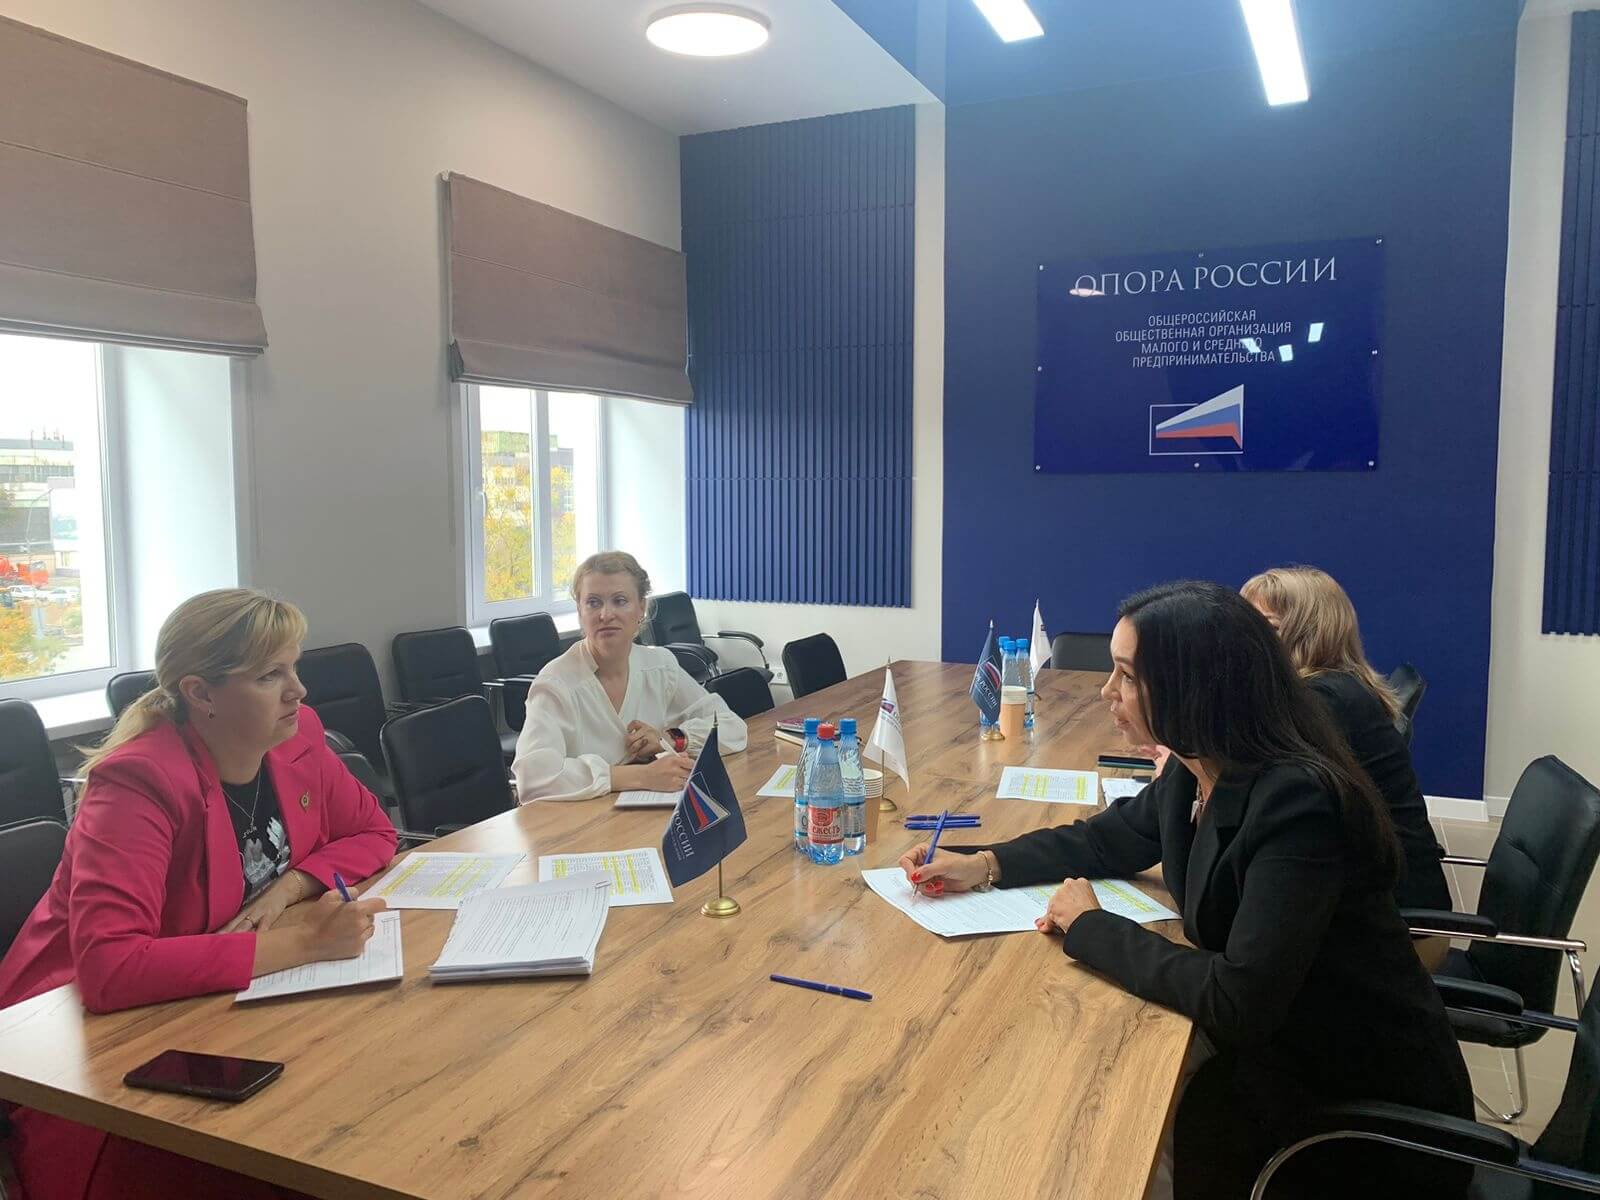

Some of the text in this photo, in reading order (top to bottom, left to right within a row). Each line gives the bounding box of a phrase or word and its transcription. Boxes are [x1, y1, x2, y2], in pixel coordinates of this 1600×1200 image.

[1074, 256, 1338, 296] ОПОРА РОССИИ
[1148, 309, 1257, 327] ОБЩЕРОССИЙСКАЯ
[1115, 321, 1292, 343] ОБЩЕСТВЕННАЯ ОРГАНИЗАЦИЯ
[1141, 337, 1263, 354] МАЛОГО И СРЕДНО
[1132, 351, 1276, 369] ПРЕДПРИНИМАТЕЛЬСТВА
